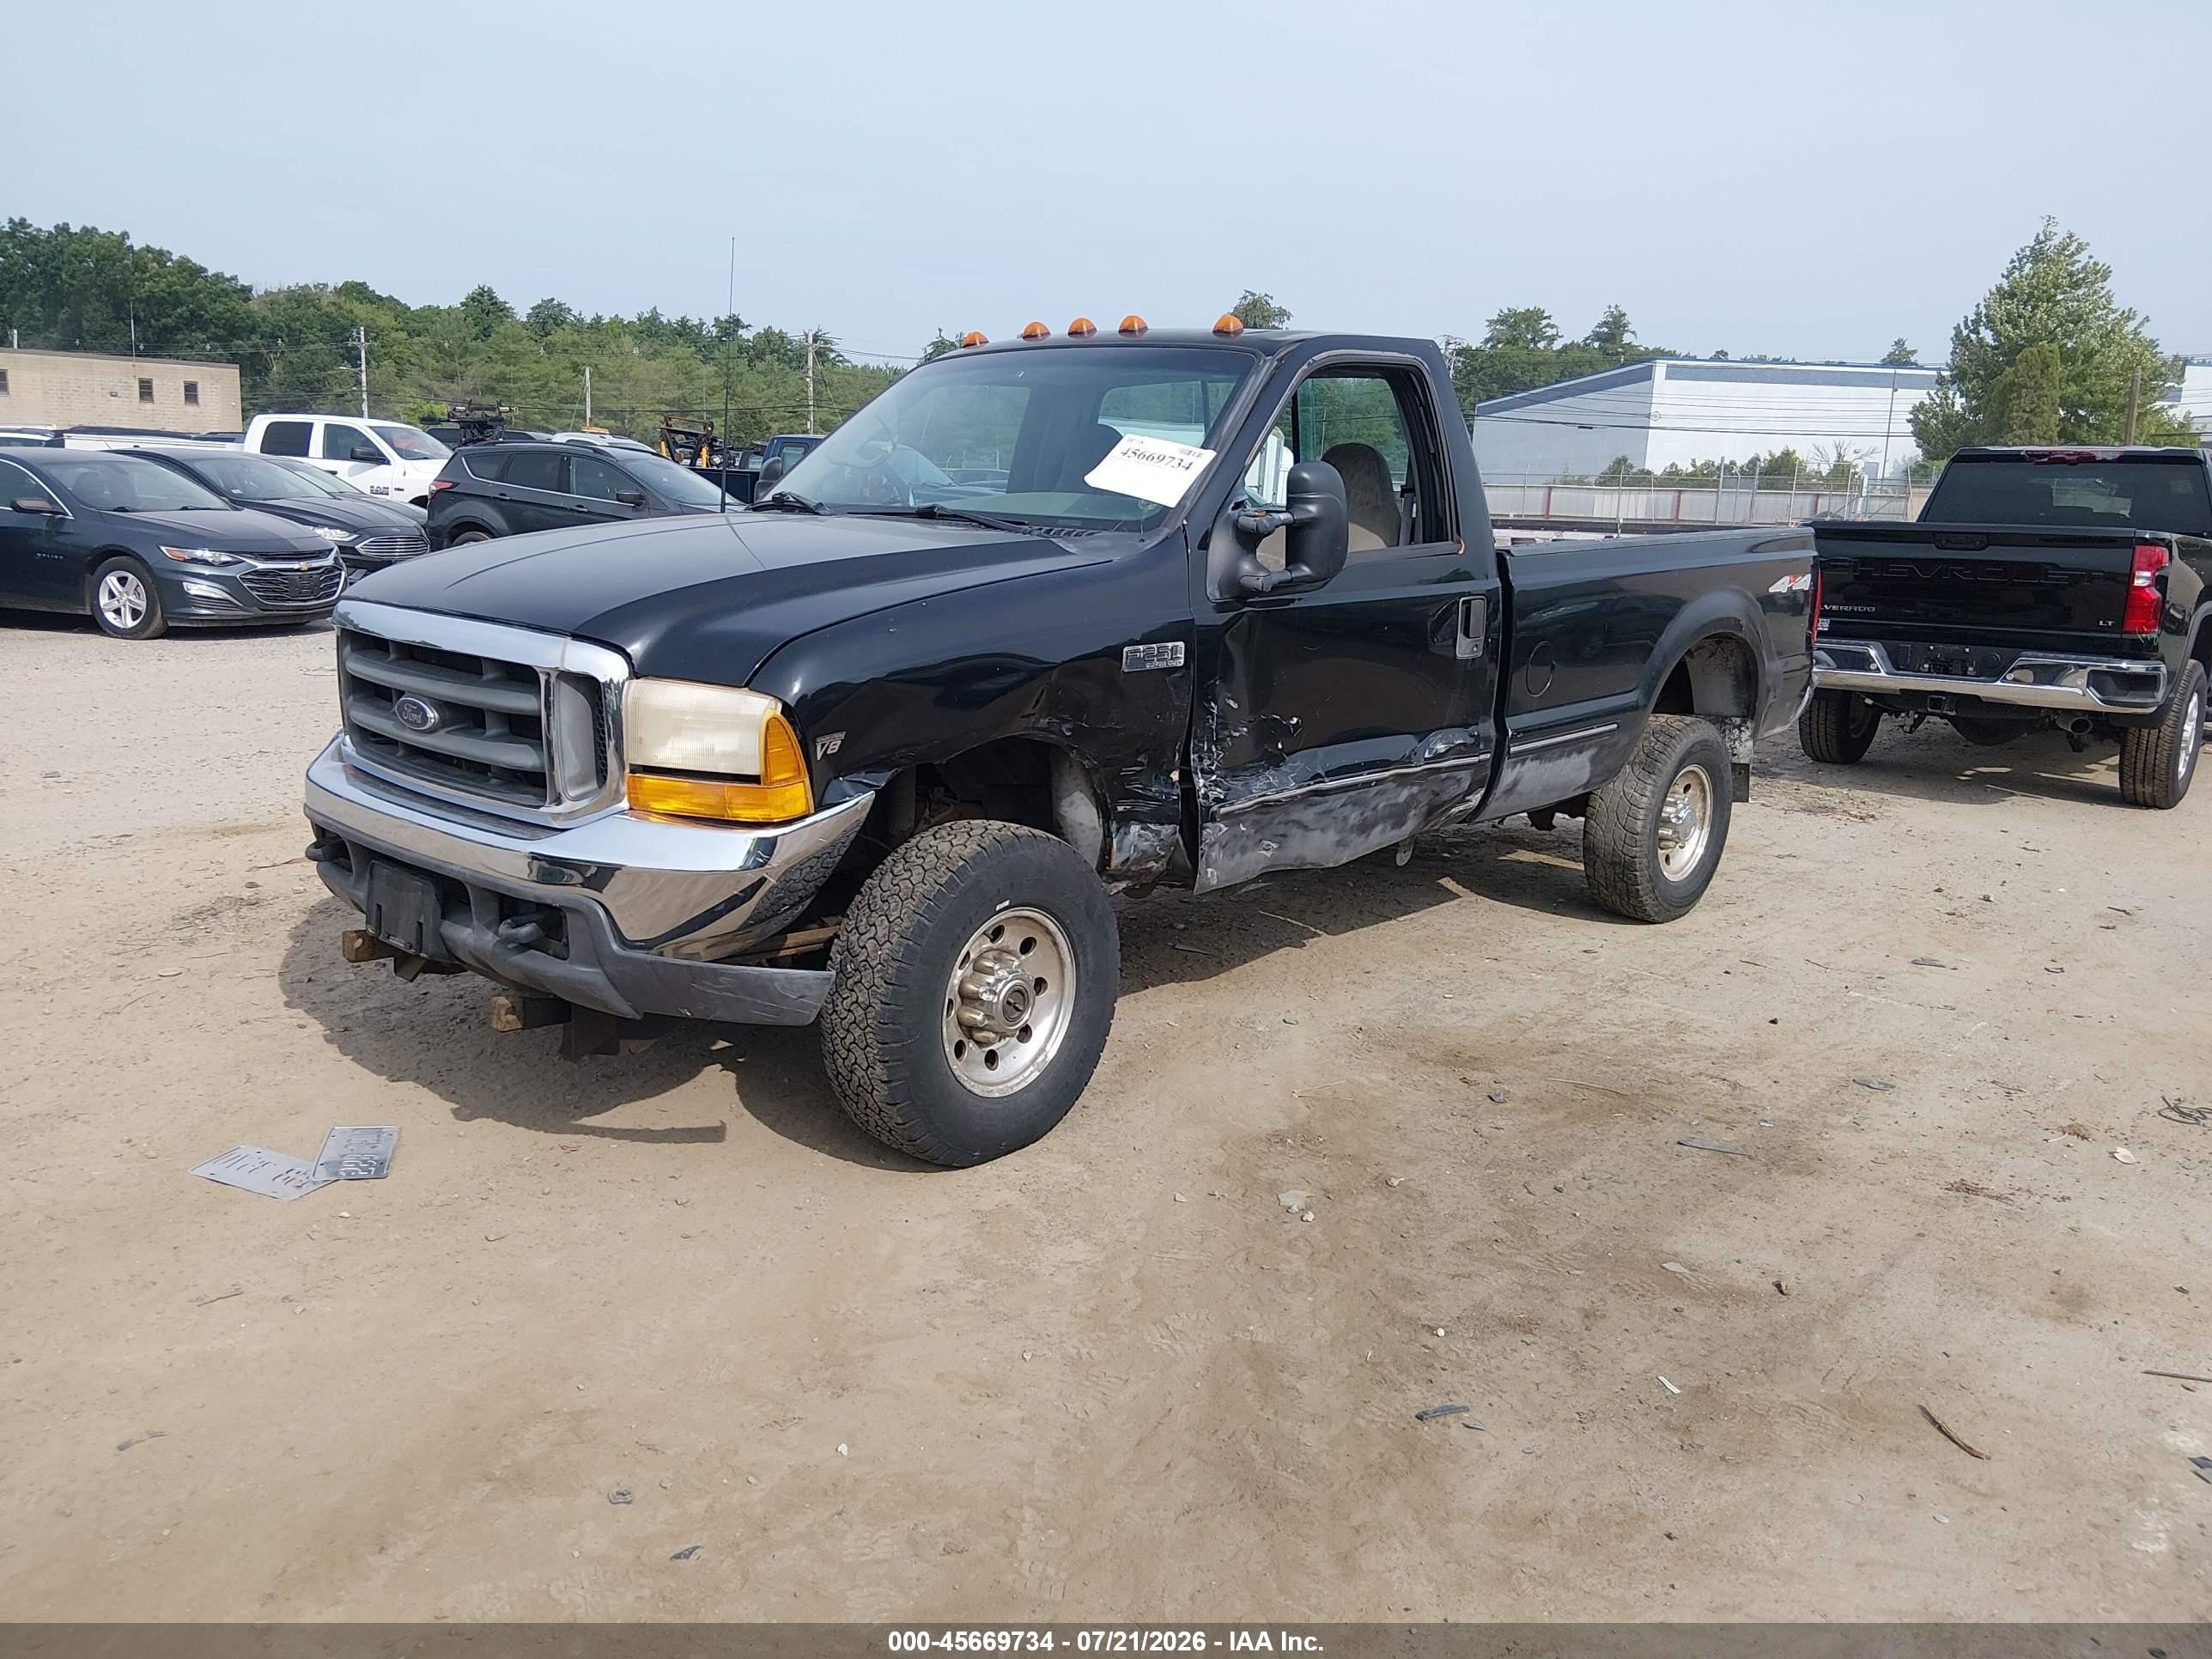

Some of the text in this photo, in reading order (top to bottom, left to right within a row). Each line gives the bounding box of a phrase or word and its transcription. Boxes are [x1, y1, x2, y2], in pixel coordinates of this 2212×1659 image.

[1121, 447, 1194, 471] 45669734
[1820, 604, 1876, 612] LVERADO
[403, 703, 423, 724] Ford
[816, 739, 842, 761] V8
